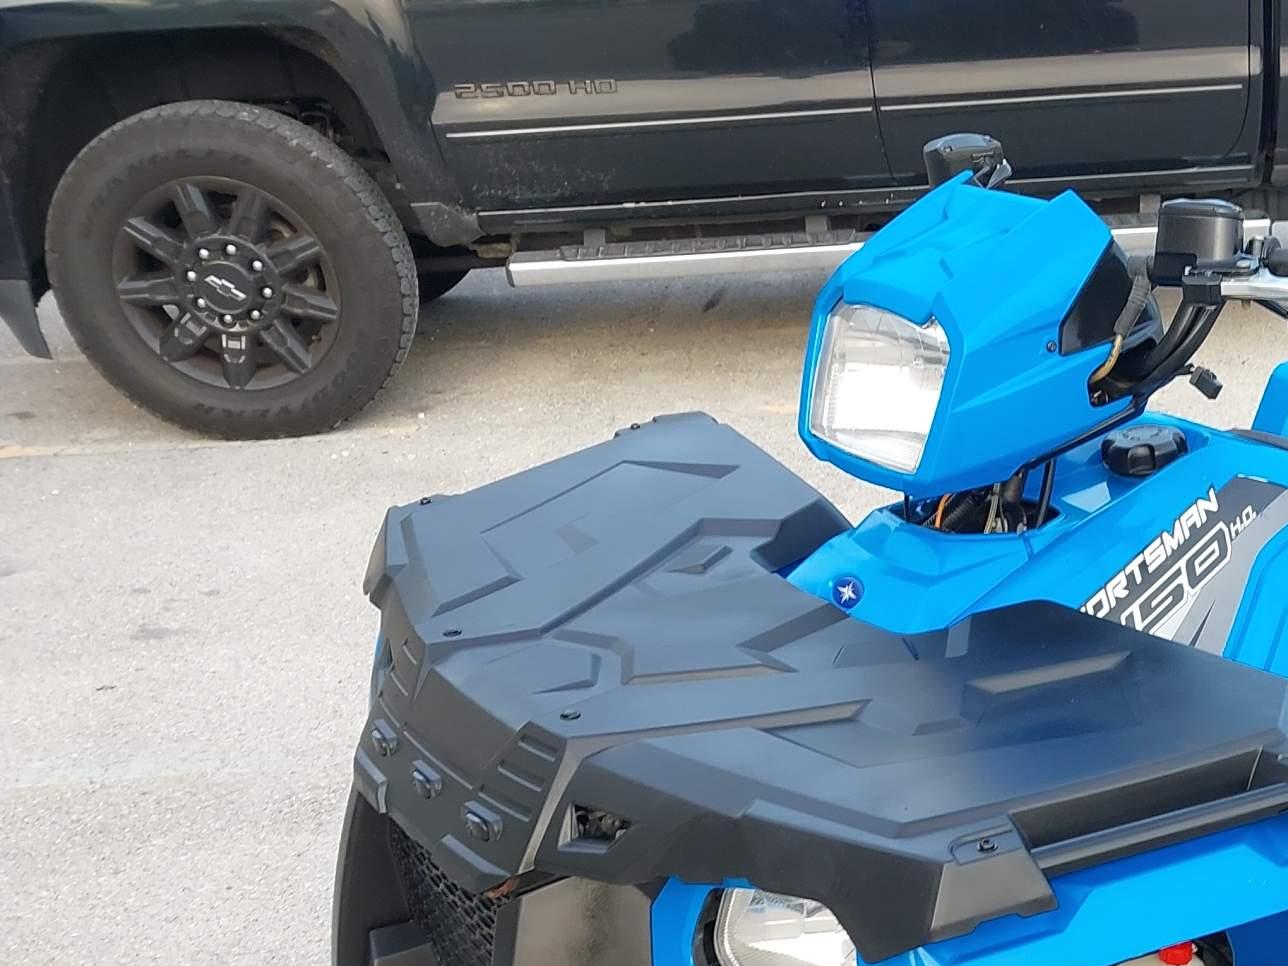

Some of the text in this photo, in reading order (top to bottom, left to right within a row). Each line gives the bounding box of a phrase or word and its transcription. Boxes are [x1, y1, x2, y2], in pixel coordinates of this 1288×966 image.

[454, 78, 618, 99] 2500 HD
[1080, 487, 1219, 618] ORTSMAN
[1120, 520, 1232, 635] 50
